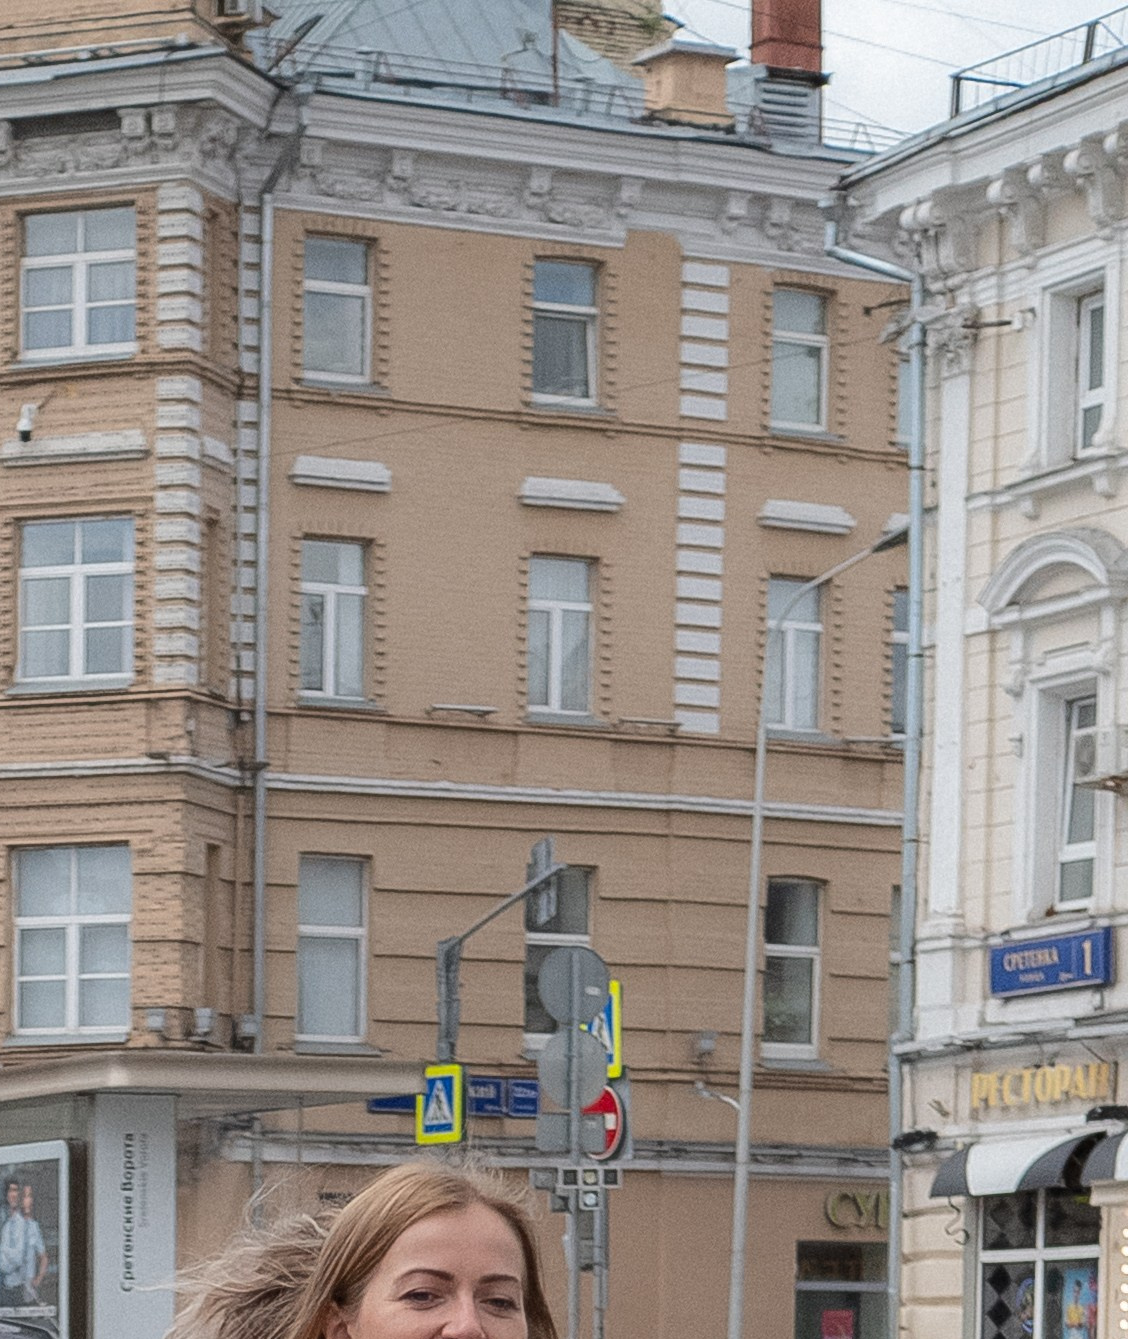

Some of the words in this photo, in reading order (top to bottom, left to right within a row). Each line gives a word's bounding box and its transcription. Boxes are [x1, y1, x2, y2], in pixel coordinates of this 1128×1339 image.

[1082, 939, 1092, 976] 1
[971, 1063, 1110, 1108] РЕСТОРАН
[120, 1132, 136, 1192] Ворота
[120, 1196, 135, 1292] Сретенские
